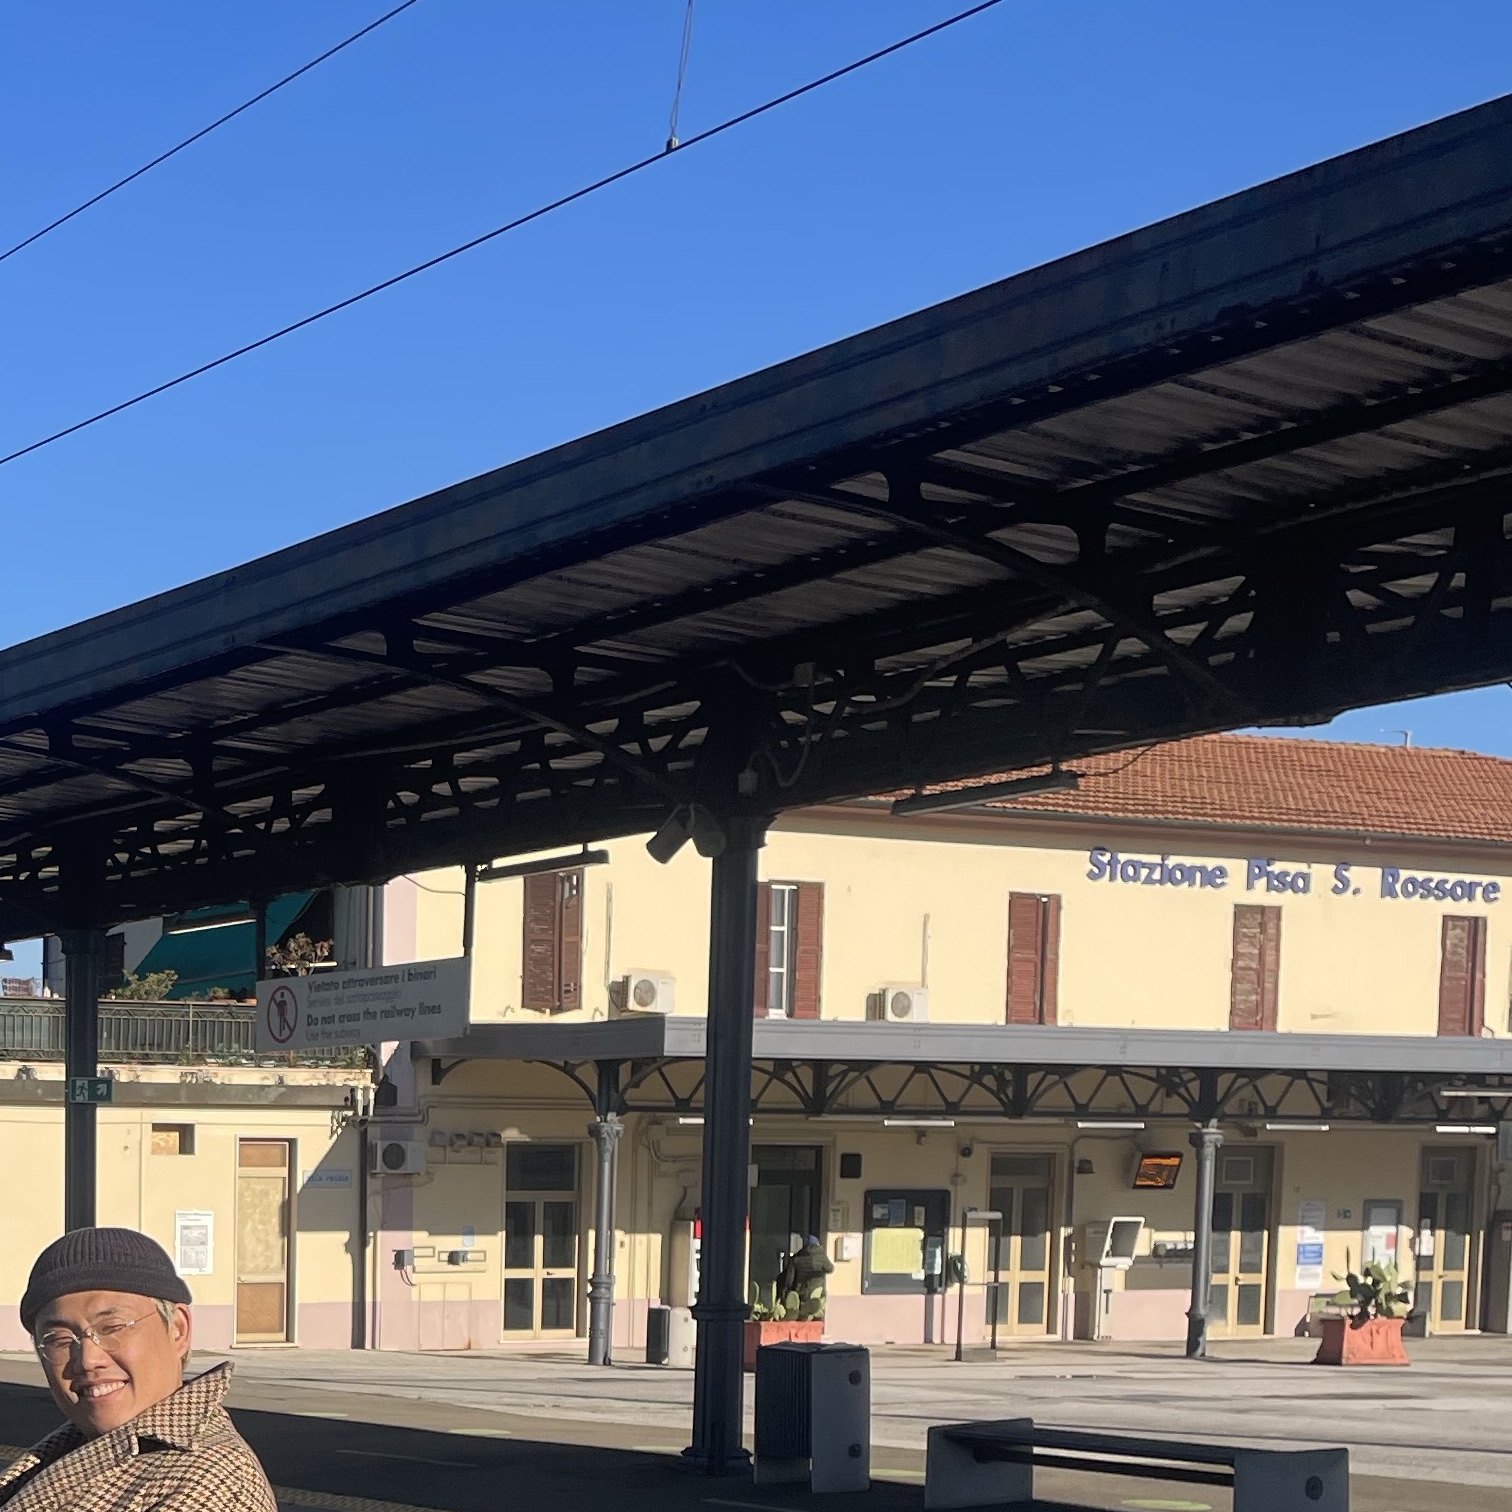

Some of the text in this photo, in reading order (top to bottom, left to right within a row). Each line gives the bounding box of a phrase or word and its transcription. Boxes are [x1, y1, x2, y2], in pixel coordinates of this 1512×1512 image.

[1087, 846, 1501, 903] Stazione Pisa S. Rossore
[307, 1013, 319, 1027] Do
[321, 1013, 336, 1025] not
[339, 1012, 361, 1024] cross
[363, 1007, 377, 1021] the
[380, 1004, 416, 1020] railway
